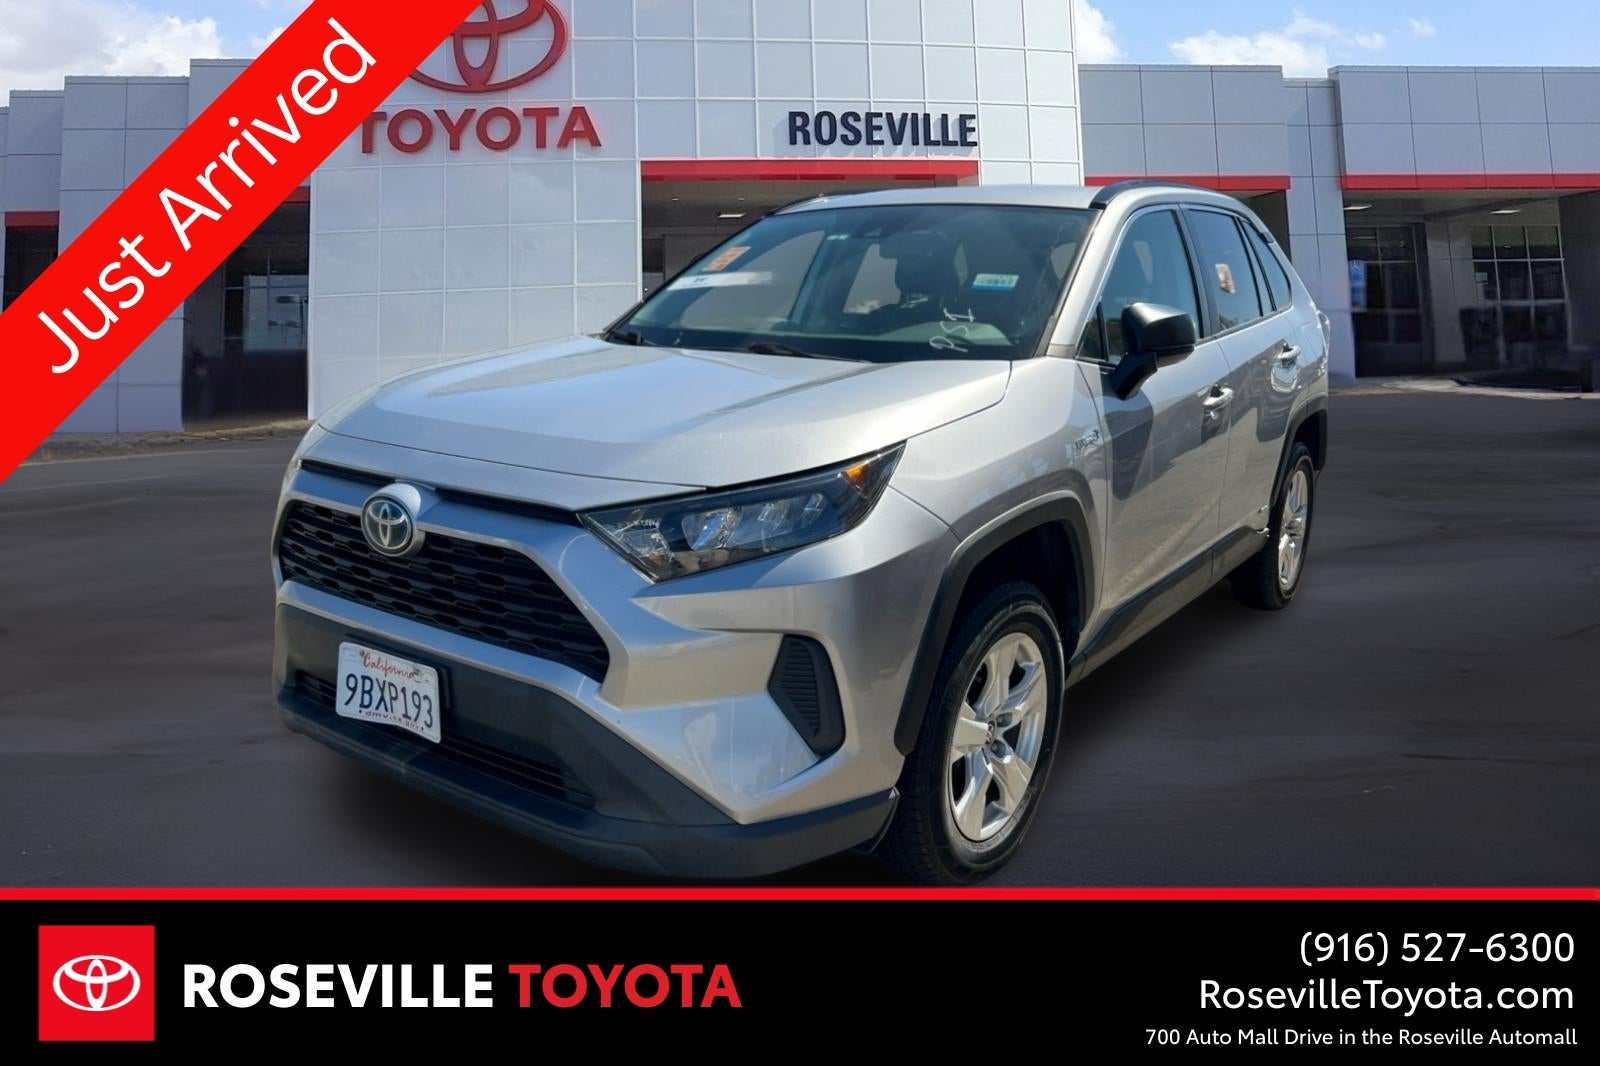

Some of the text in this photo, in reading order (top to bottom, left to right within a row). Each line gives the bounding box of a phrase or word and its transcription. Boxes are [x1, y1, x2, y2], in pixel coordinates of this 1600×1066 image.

[361, 106, 602, 154] TOYOTA
[788, 110, 978, 147] ROSEVILLE
[362, 652, 422, 683] California
[343, 673, 434, 729] 9BXP193
